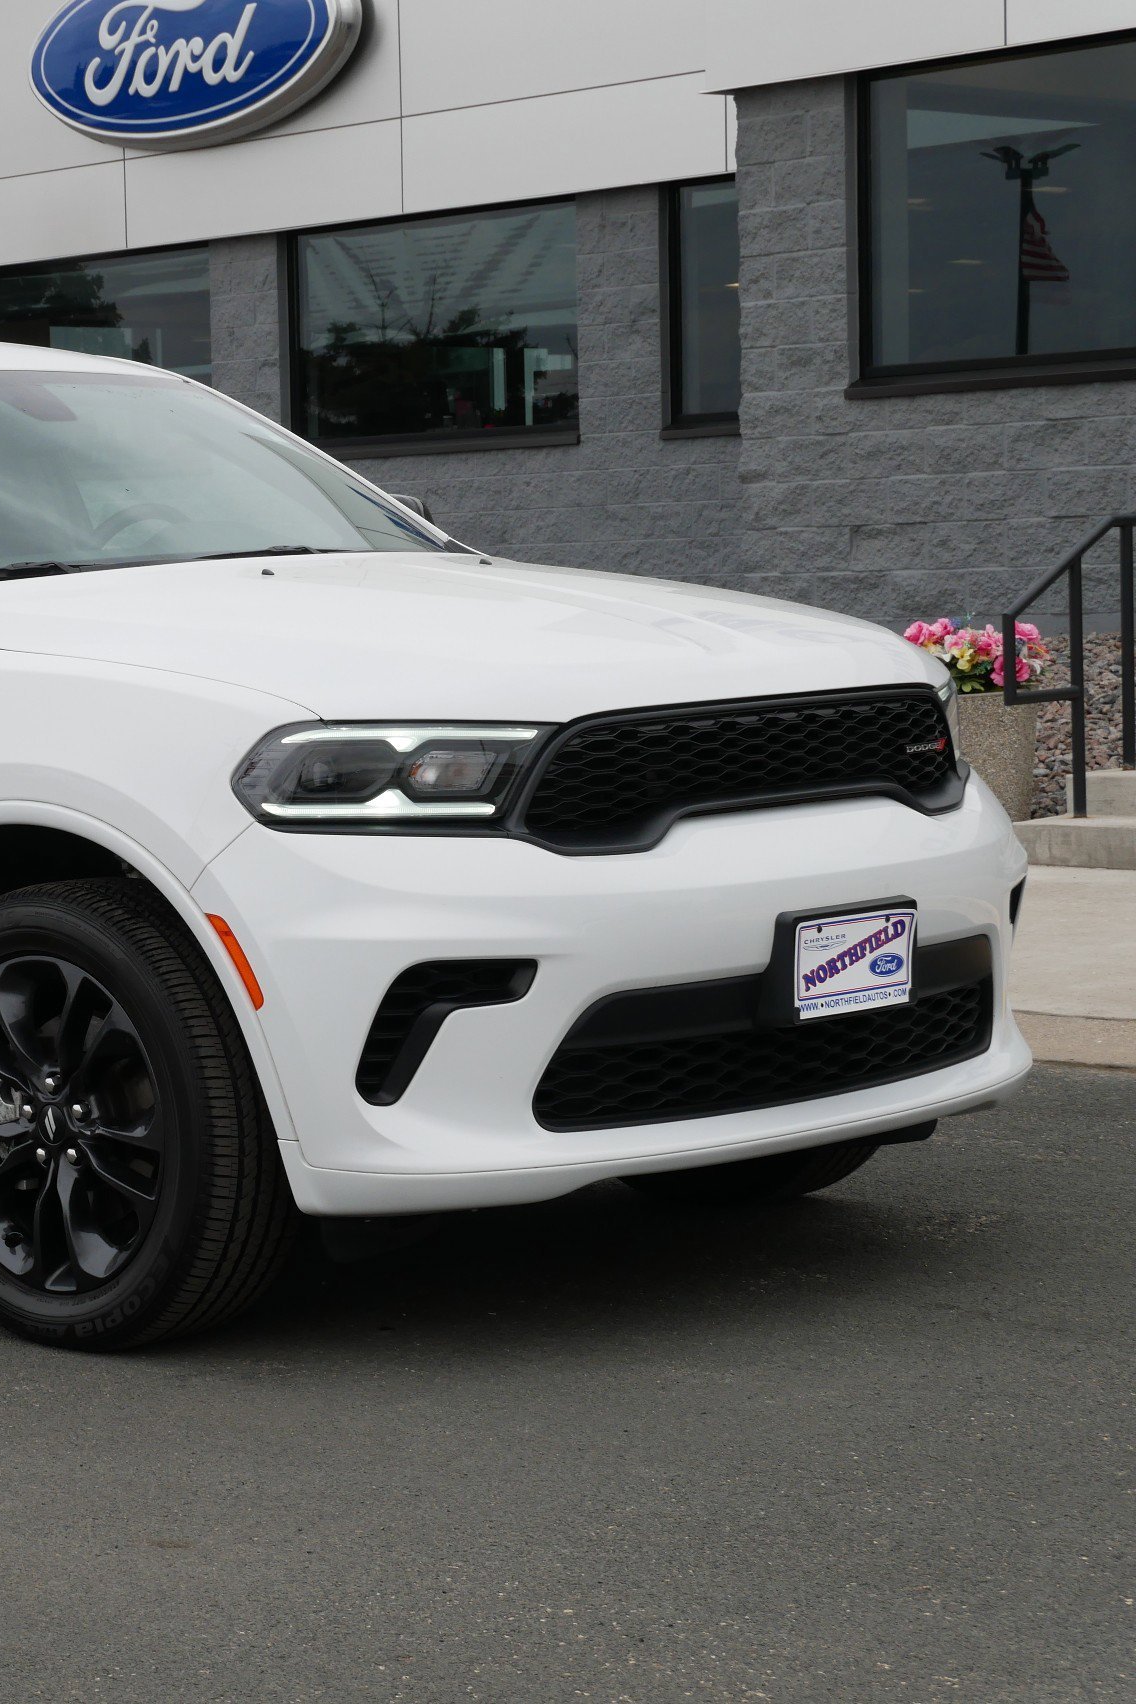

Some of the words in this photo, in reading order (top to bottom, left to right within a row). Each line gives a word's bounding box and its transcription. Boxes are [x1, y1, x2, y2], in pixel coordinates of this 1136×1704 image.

[84, 0, 257, 106] Ford
[802, 918, 906, 992] NORTHFIELD
[804, 933, 847, 945] CHRYSLER
[875, 956, 897, 973] Ford
